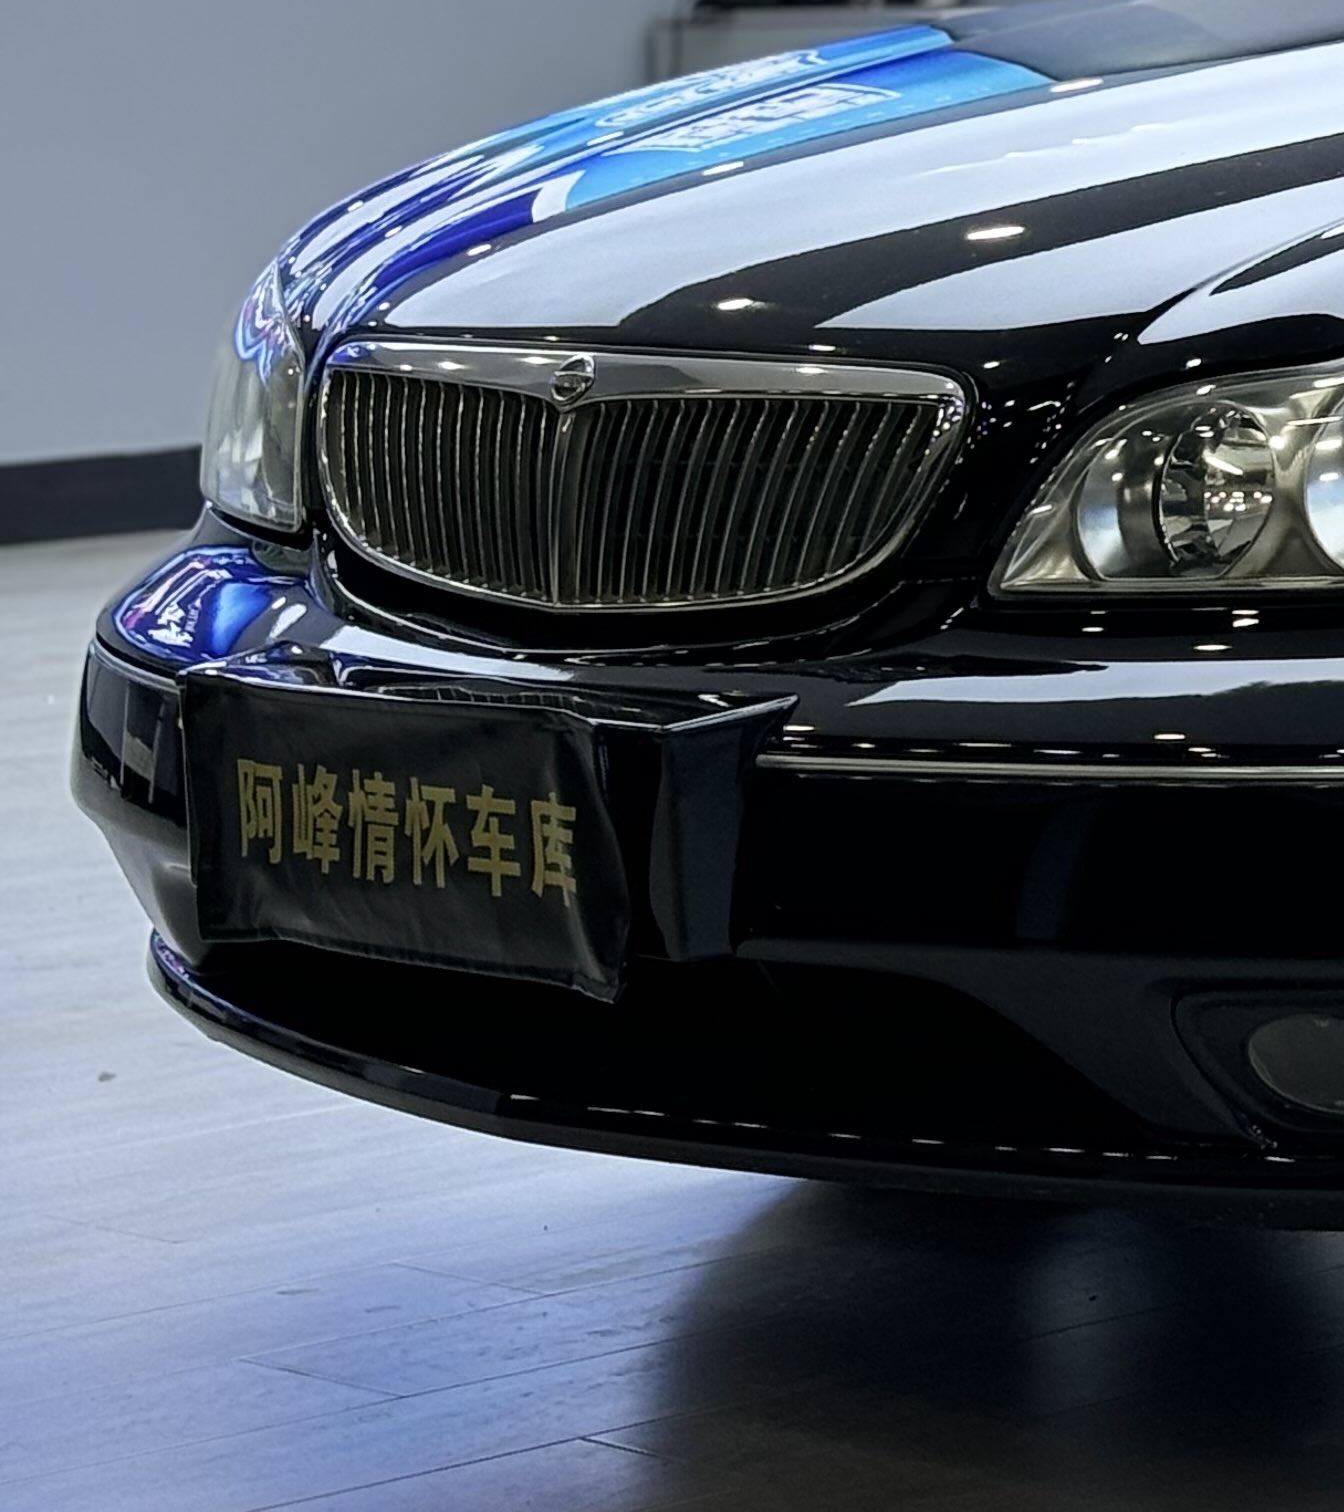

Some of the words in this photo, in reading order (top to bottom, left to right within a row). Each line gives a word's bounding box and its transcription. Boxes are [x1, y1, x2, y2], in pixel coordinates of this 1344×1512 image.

[236, 758, 578, 907] 阿峰情怀车库
